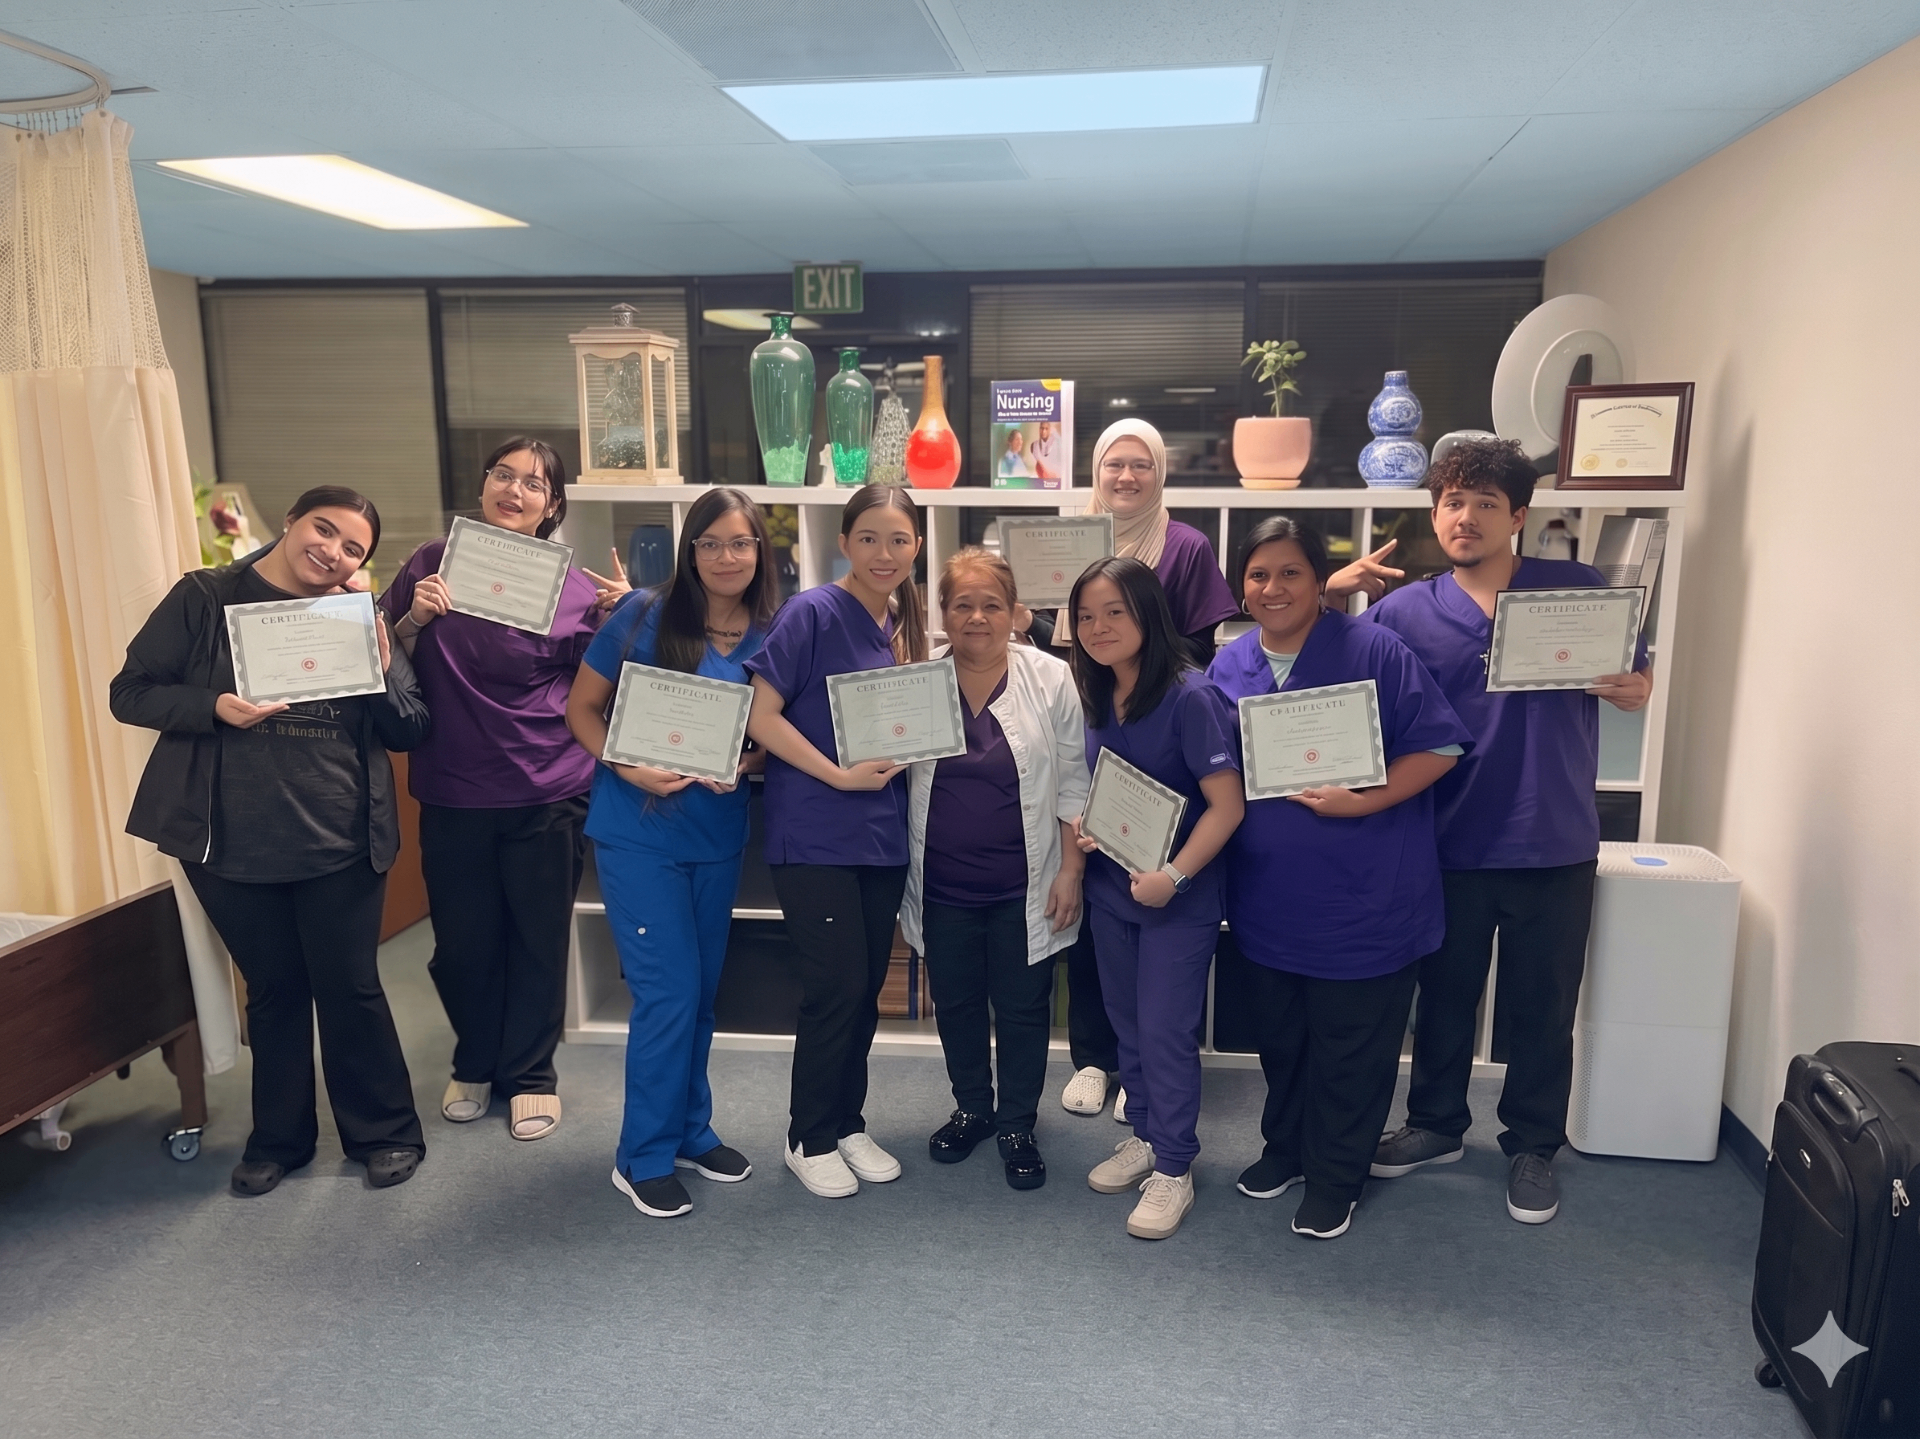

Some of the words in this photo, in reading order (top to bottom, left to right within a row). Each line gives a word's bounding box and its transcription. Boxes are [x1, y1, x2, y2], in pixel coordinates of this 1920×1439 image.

[803, 268, 855, 309] EXIT
[997, 393, 1054, 412] Nursing
[650, 682, 722, 703] CERTIFICATE
